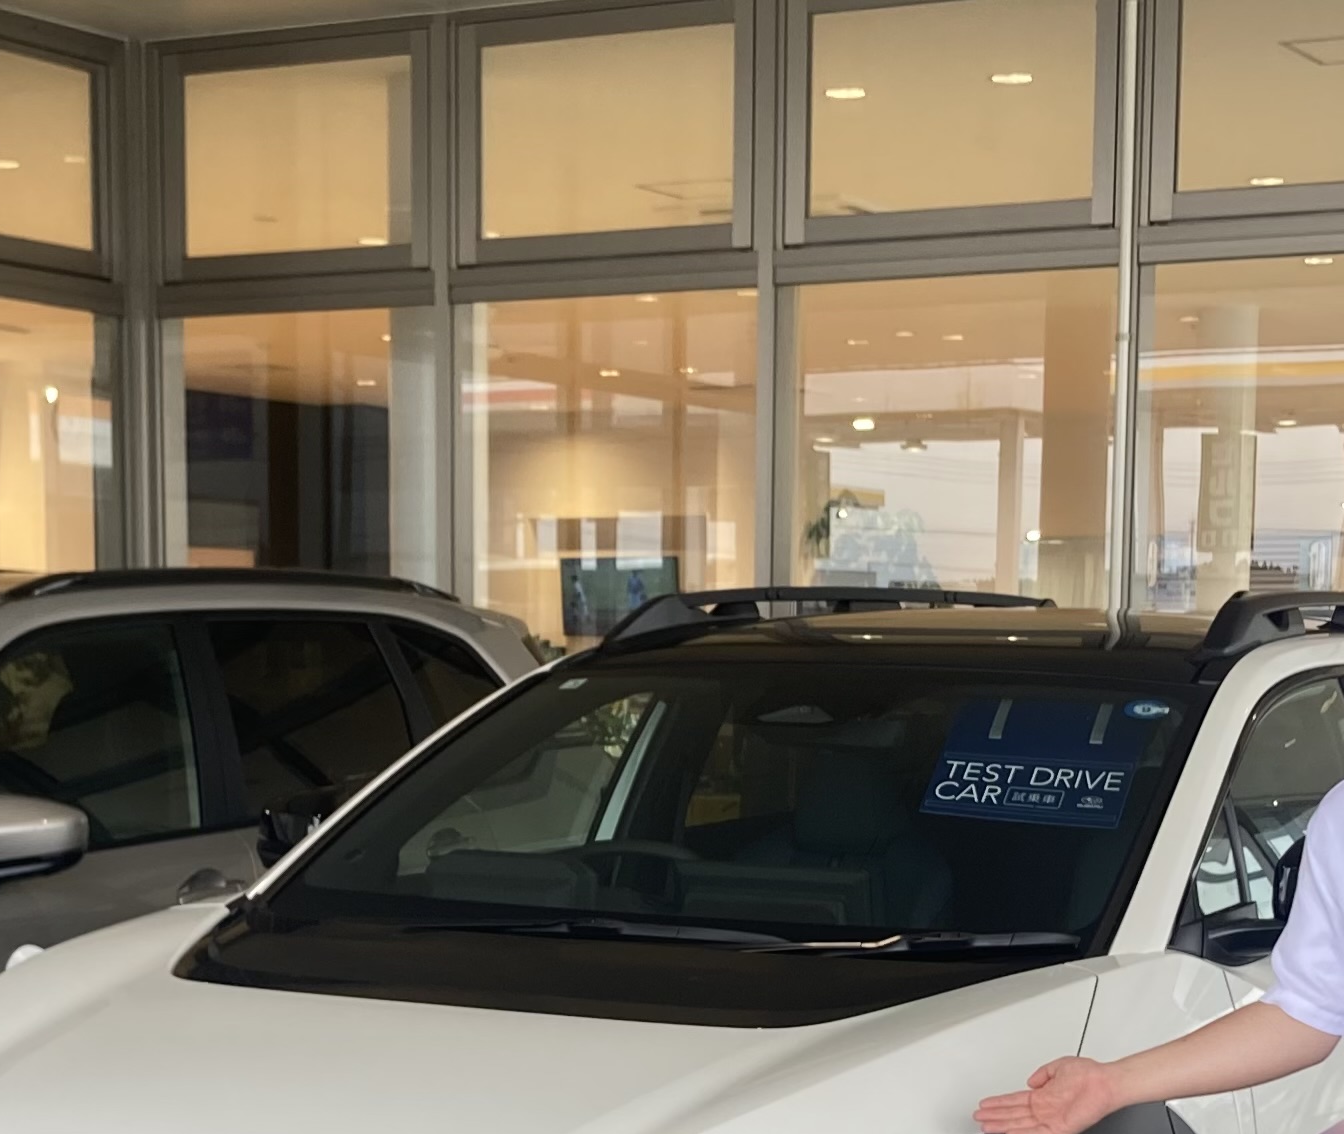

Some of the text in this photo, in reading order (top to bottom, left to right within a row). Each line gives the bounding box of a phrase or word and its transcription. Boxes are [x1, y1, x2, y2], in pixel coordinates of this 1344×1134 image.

[946, 760, 1125, 792] TEST DRIVE
[935, 780, 1057, 804] CAR 試乗車
